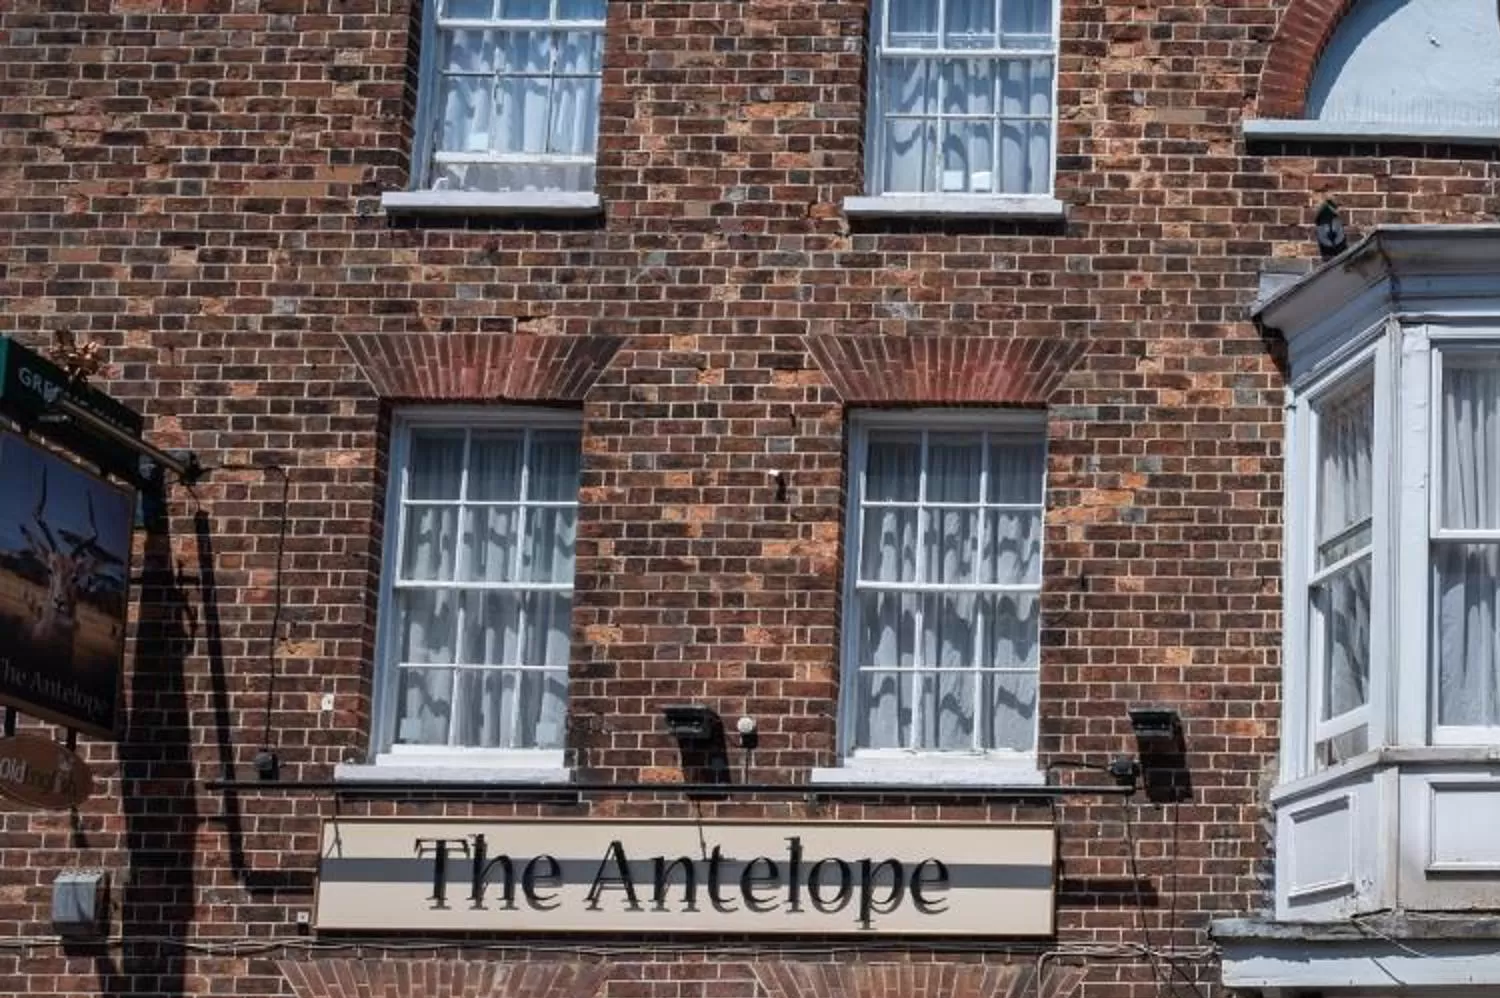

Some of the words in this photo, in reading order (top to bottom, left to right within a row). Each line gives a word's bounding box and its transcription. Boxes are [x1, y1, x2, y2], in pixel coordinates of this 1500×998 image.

[0, 756, 27, 784] Old
[415, 834, 562, 910] The
[584, 836, 950, 931] Antelope
